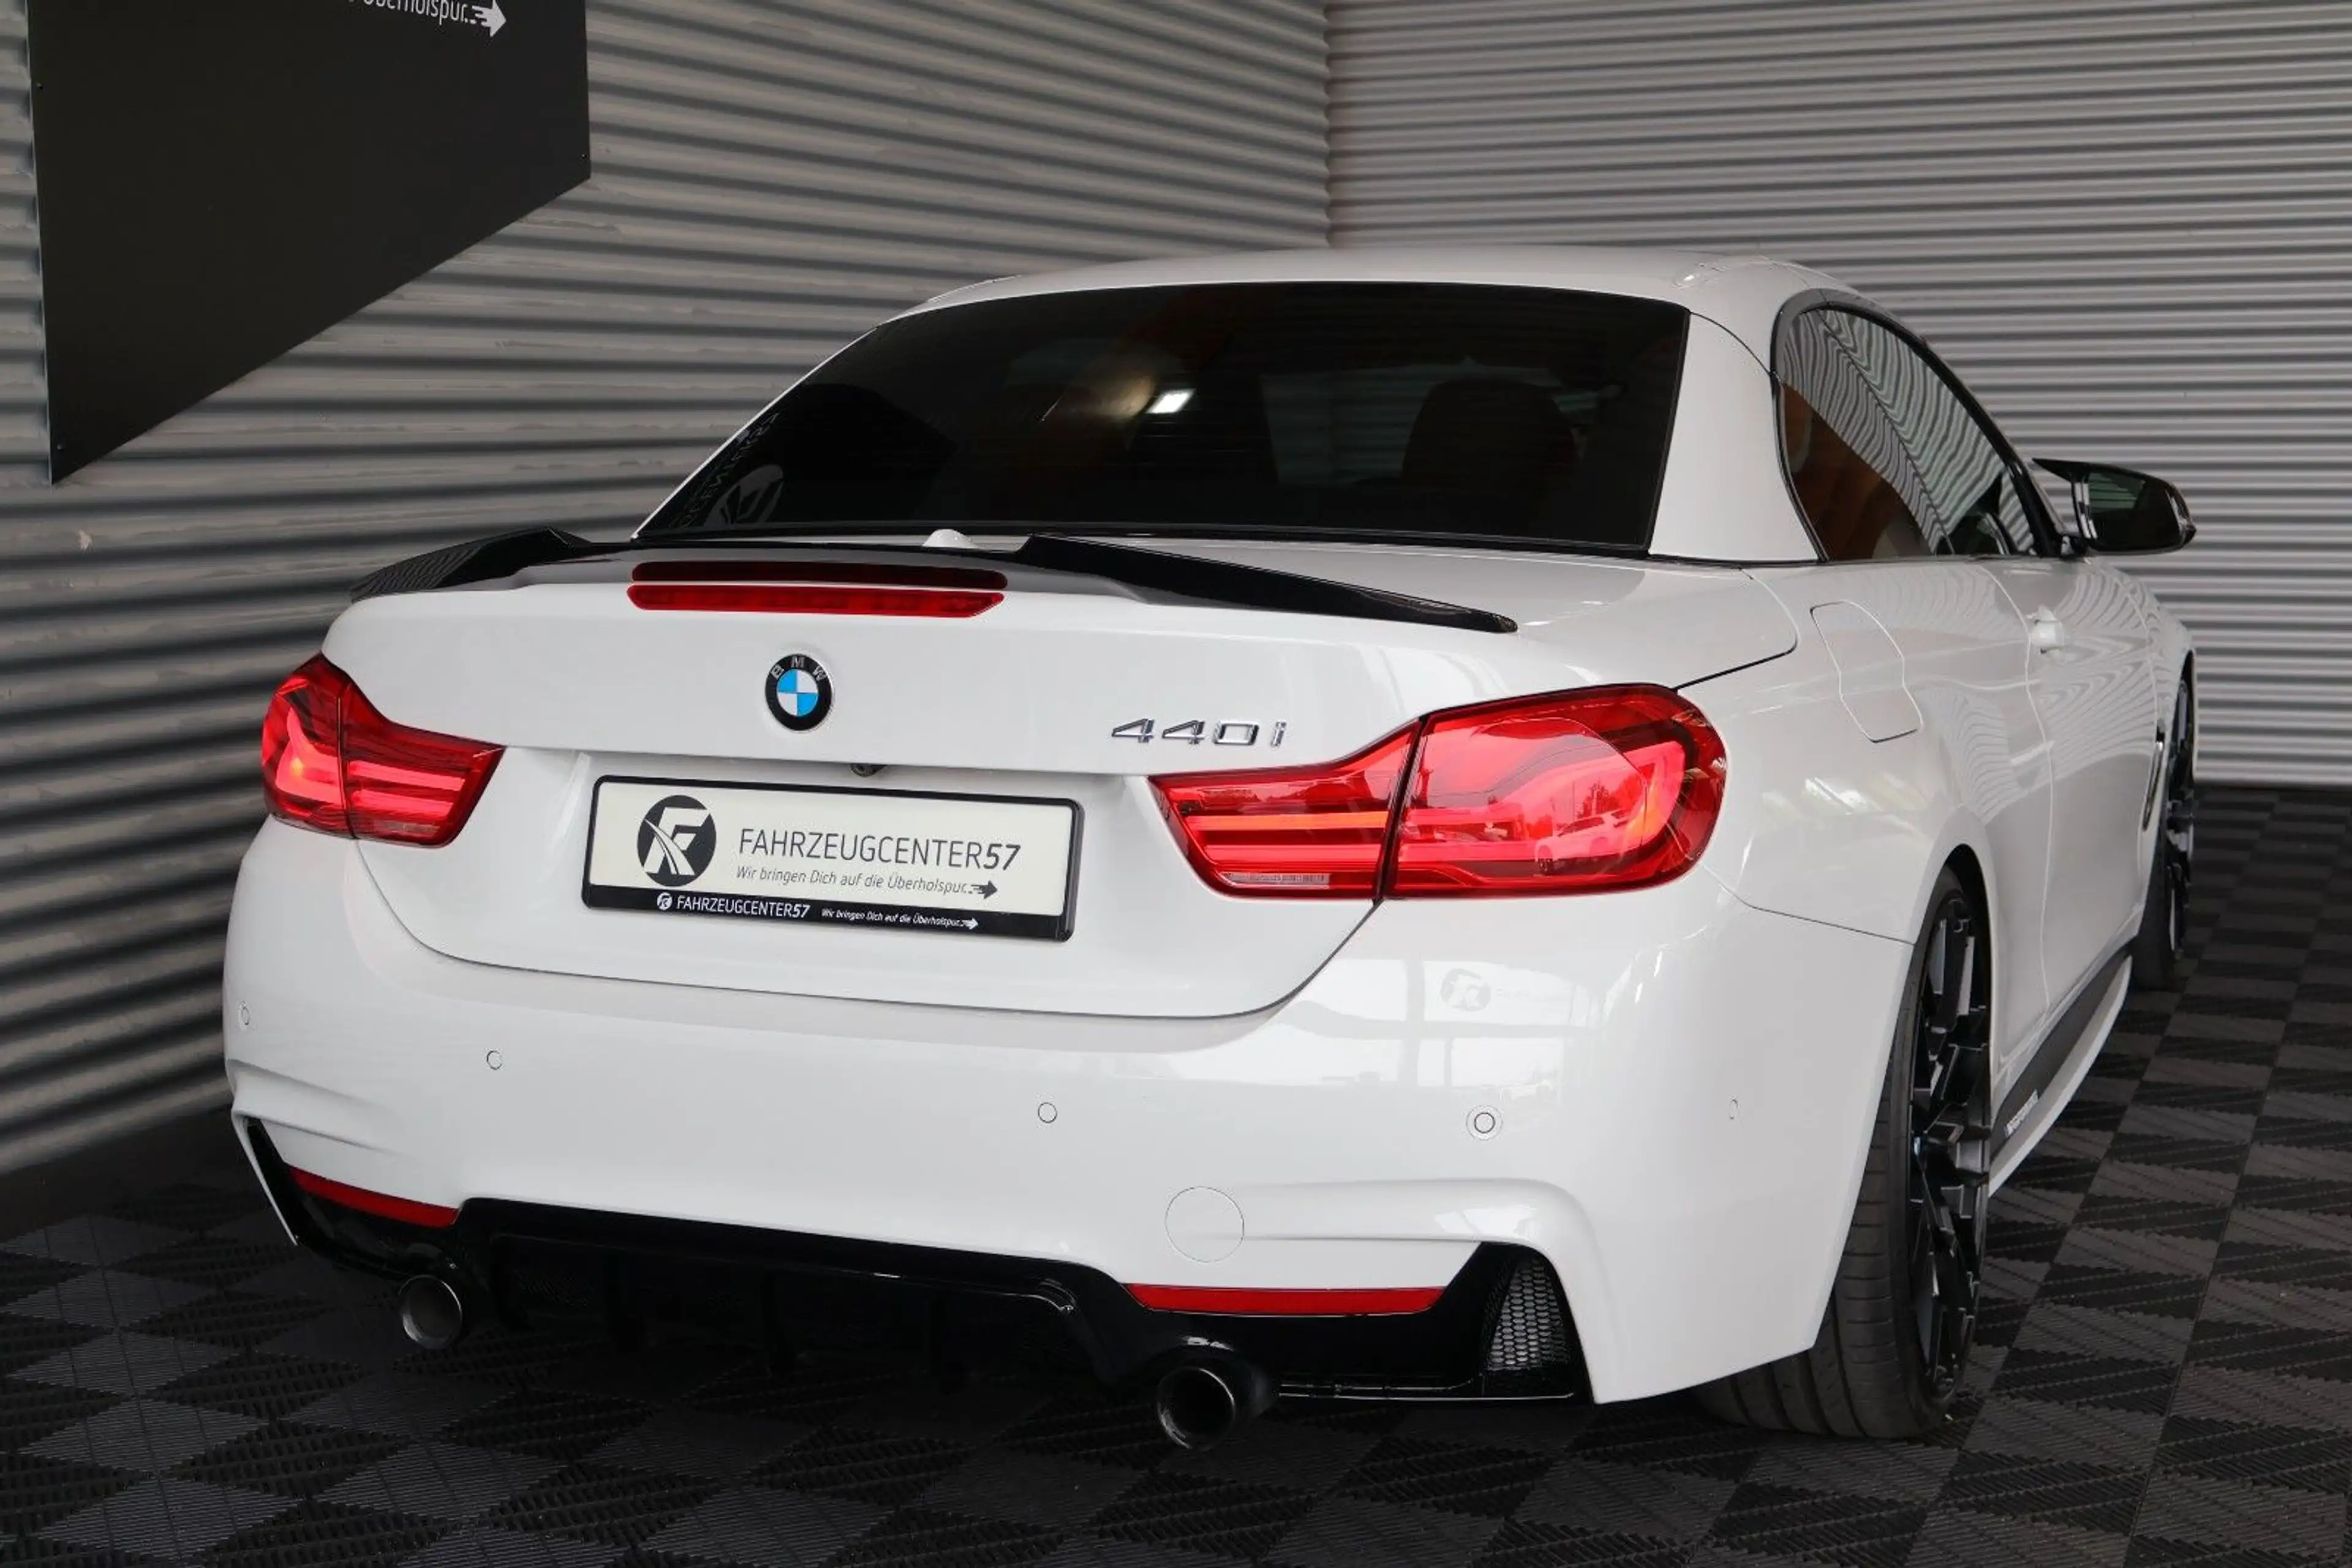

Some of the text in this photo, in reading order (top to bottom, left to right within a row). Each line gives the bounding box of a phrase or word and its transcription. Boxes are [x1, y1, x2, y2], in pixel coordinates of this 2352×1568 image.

[769, 655, 827, 681] BMW
[1111, 718, 1287, 747] 440i
[739, 828, 1021, 871] FAHRZEUGCENTER57
[736, 865, 756, 880] Wir
[760, 867, 807, 886] bringen
[810, 869, 837, 884] Dich
[840, 872, 862, 886] auf
[864, 873, 884, 888] die
[676, 894, 810, 918] FAHRZEUGCENTER57
[821, 908, 834, 918] Wir
[836, 909, 865, 921] bringen
[865, 910, 883, 922] Dich
[884, 912, 897, 922] auf
[899, 913, 911, 924] die
